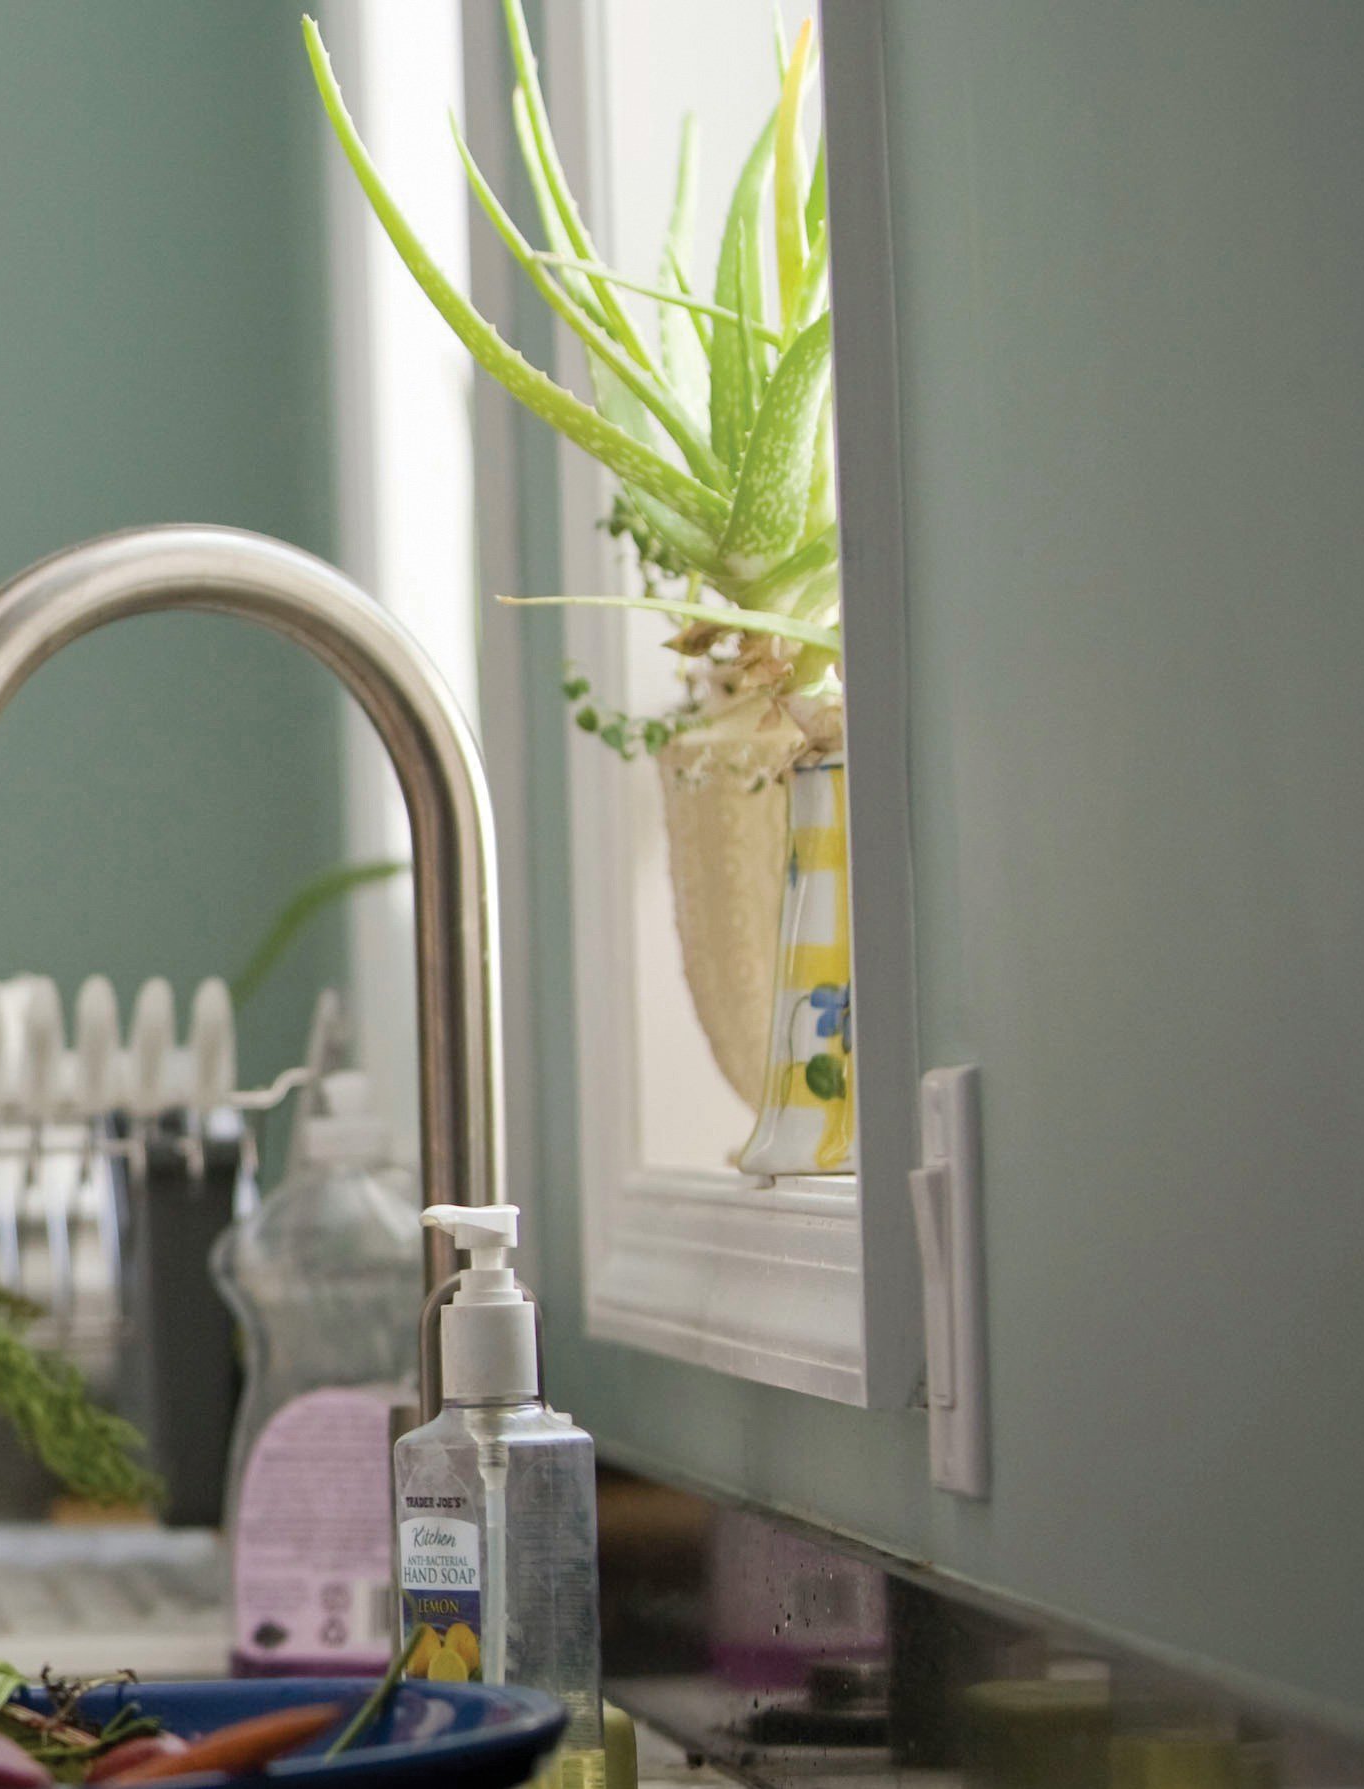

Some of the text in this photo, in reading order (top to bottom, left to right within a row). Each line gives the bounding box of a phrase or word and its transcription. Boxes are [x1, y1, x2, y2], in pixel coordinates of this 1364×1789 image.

[406, 1496, 434, 1508] TRADER
[412, 1526, 456, 1548] Kitchen
[407, 1555, 468, 1567] ANTI-BACTERIAL
[404, 1567, 476, 1584] HAND SOAP
[418, 1599, 459, 1614] LEMON
